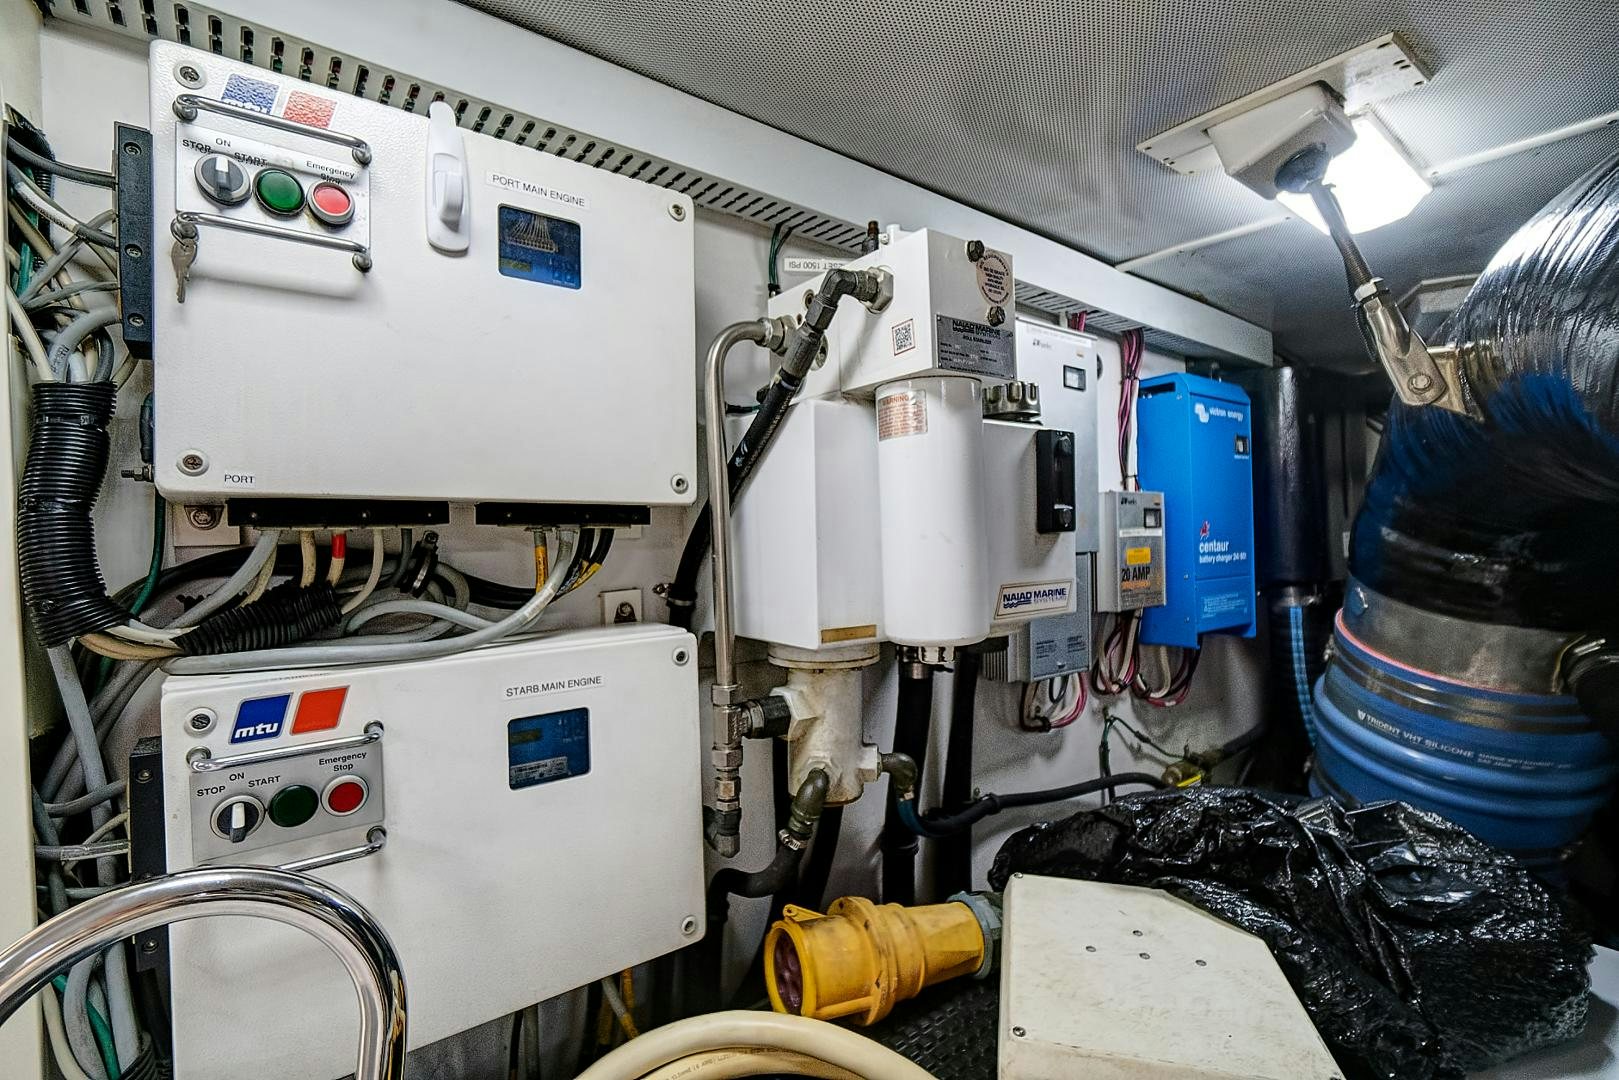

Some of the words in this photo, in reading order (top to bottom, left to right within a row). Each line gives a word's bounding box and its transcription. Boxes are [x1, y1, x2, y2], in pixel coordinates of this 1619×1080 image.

[182, 139, 212, 153] STOP
[215, 137, 231, 147] ON
[306, 160, 355, 180] Emergency
[492, 174, 520, 189] PORT
[523, 183, 548, 197] MAIN
[550, 190, 585, 206] ENGINE
[224, 474, 256, 484] PORT
[1199, 539, 1230, 554] centaur
[1121, 567, 1130, 582] 20
[1132, 566, 1150, 580] AMP
[1003, 591, 1032, 602] NAIAD
[1034, 588, 1067, 598] MARINE
[567, 676, 602, 689] ENGINE
[234, 721, 279, 739] mtu
[1367, 714, 1400, 735] TRIDENT
[1403, 731, 1423, 743] VHT
[1425, 739, 1474, 758] SILICONE
[318, 751, 367, 766] Emergency
[333, 763, 353, 772] Stop
[229, 772, 245, 782] ON
[248, 775, 281, 788] START
[196, 785, 226, 797] STOP
